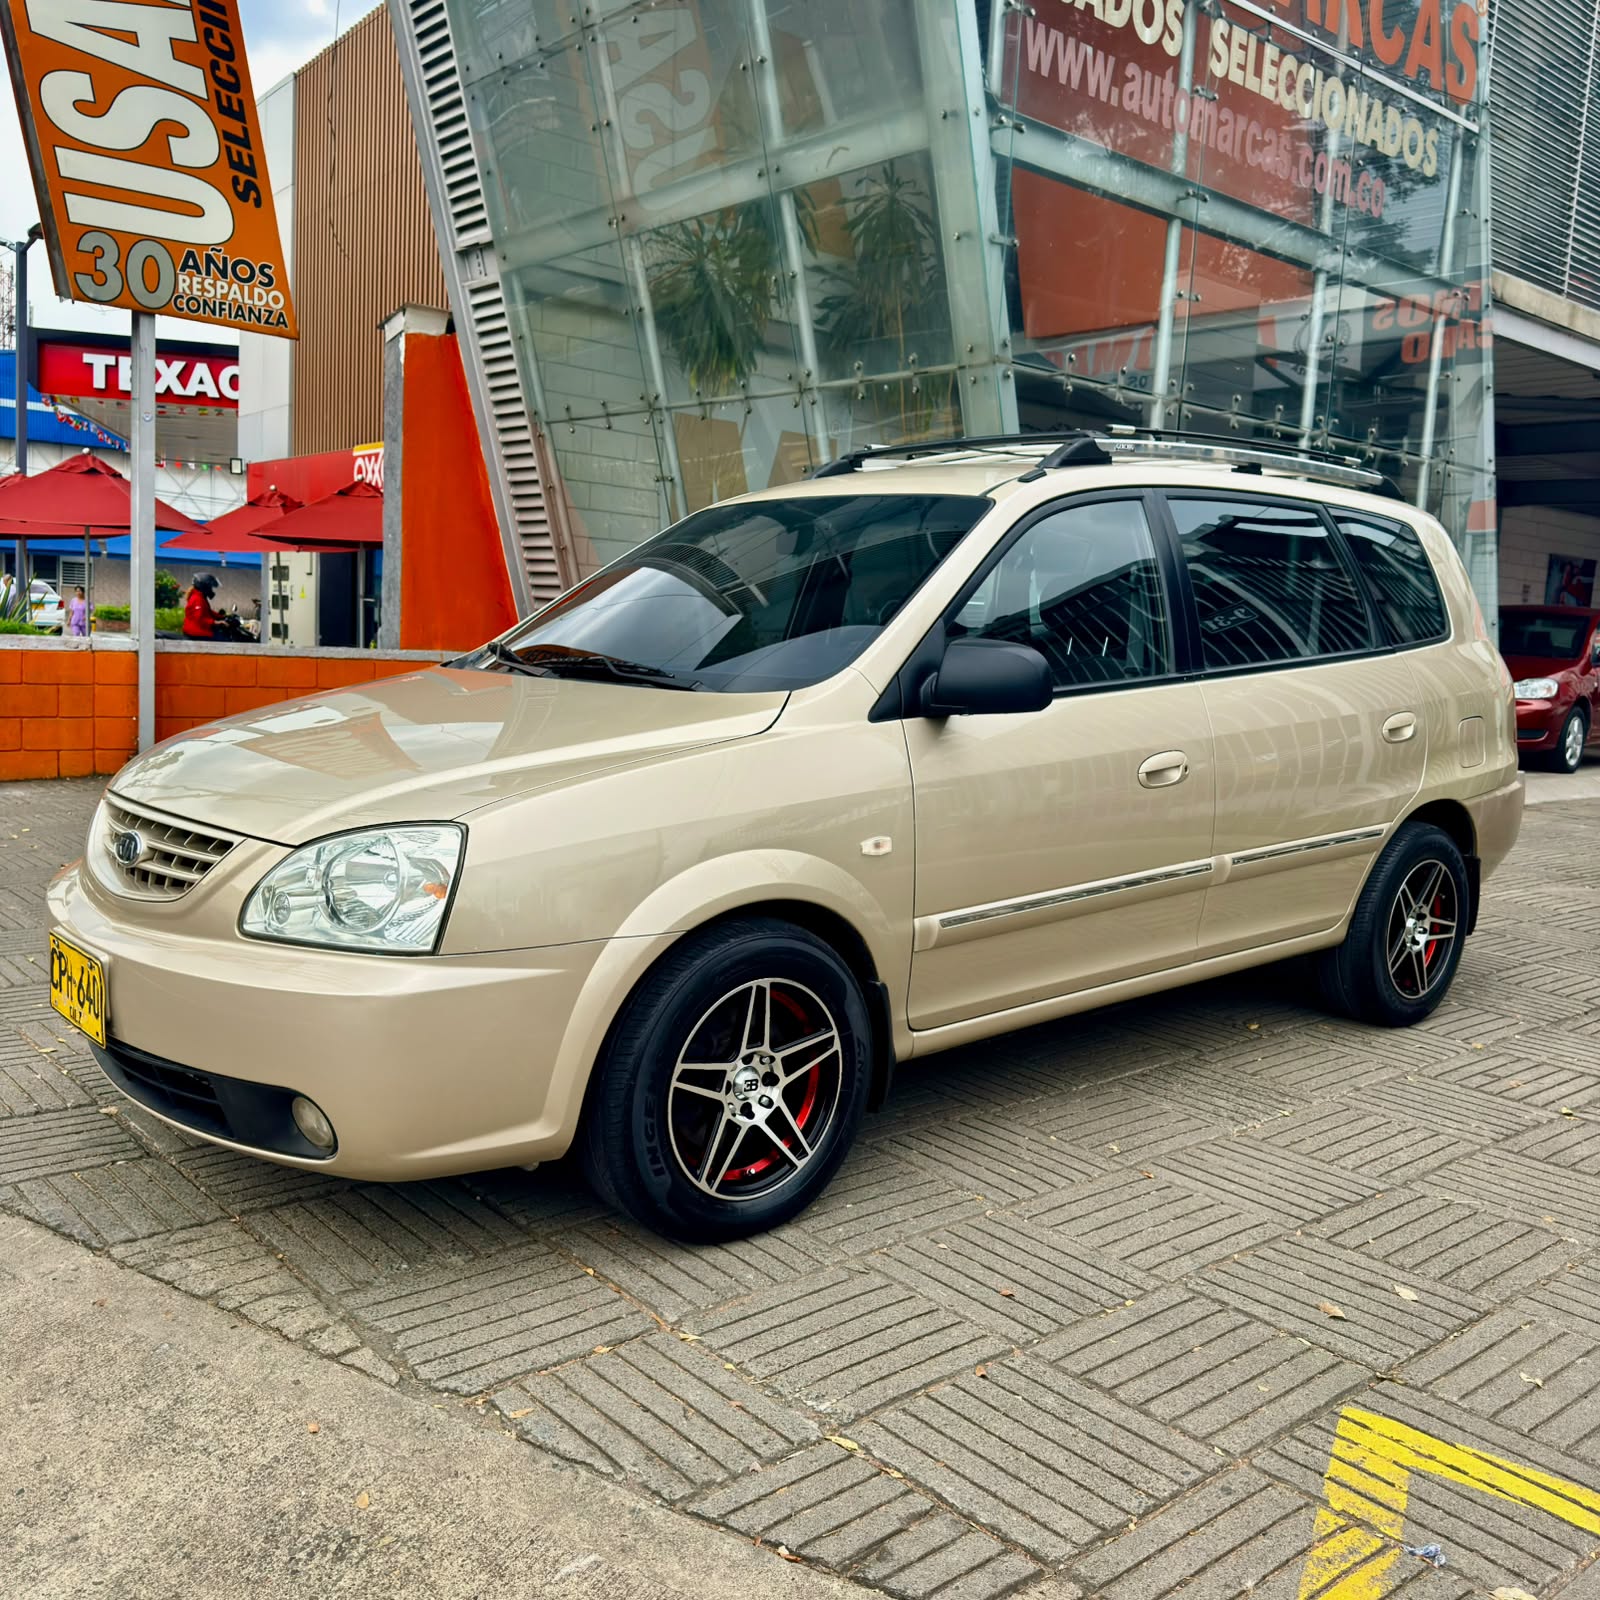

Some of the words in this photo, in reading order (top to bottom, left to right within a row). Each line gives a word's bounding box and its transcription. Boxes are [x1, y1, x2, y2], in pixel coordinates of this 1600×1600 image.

[25, 0, 235, 246] USA
[1025, 17, 1385, 218] www.automarcas.com.co
[1209, 17, 1439, 178] SELECCIONADOS
[75, 230, 177, 309] 30
[177, 246, 275, 289] AÑOS
[178, 274, 285, 310] RESPALDO
[172, 294, 289, 329] CONFIANZA
[354, 449, 384, 492] OXX
